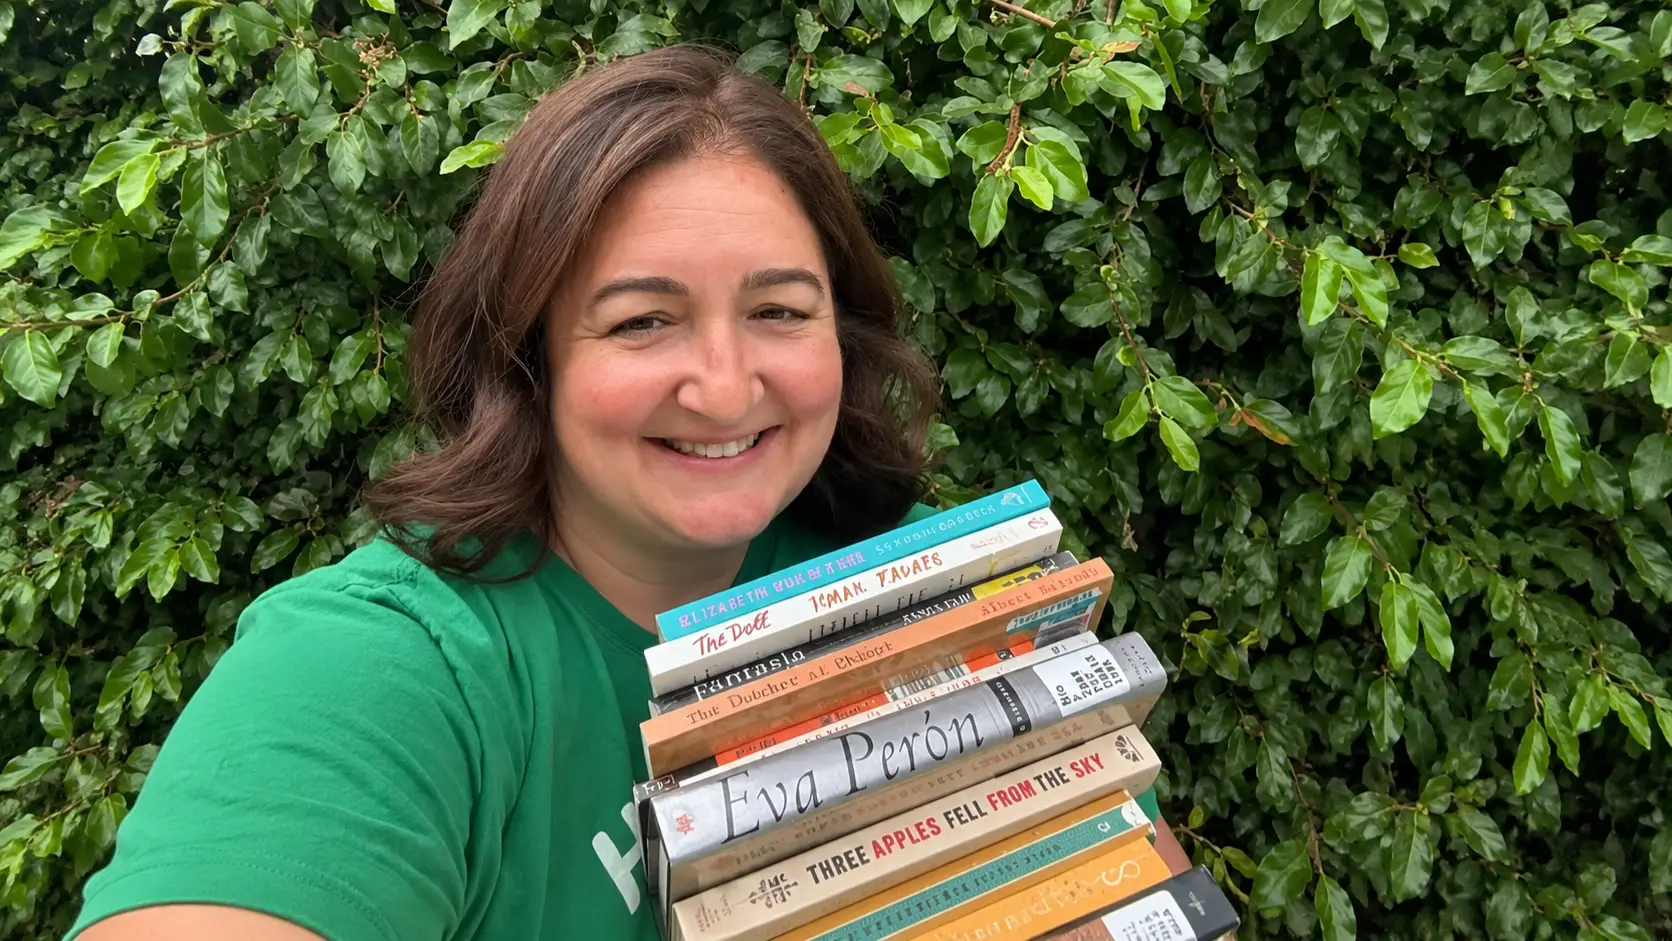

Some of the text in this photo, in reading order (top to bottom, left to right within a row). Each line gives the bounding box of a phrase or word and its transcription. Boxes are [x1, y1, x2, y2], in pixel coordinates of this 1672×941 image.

[720, 769, 823, 845] Eva
[828, 709, 984, 798] Perón
[805, 845, 871, 885] THREE
[870, 817, 942, 860] APPLES
[943, 800, 988, 829] FELL
[986, 779, 1038, 812] FROM
[1034, 767, 1071, 793] THE
[1070, 753, 1105, 779] SKY
